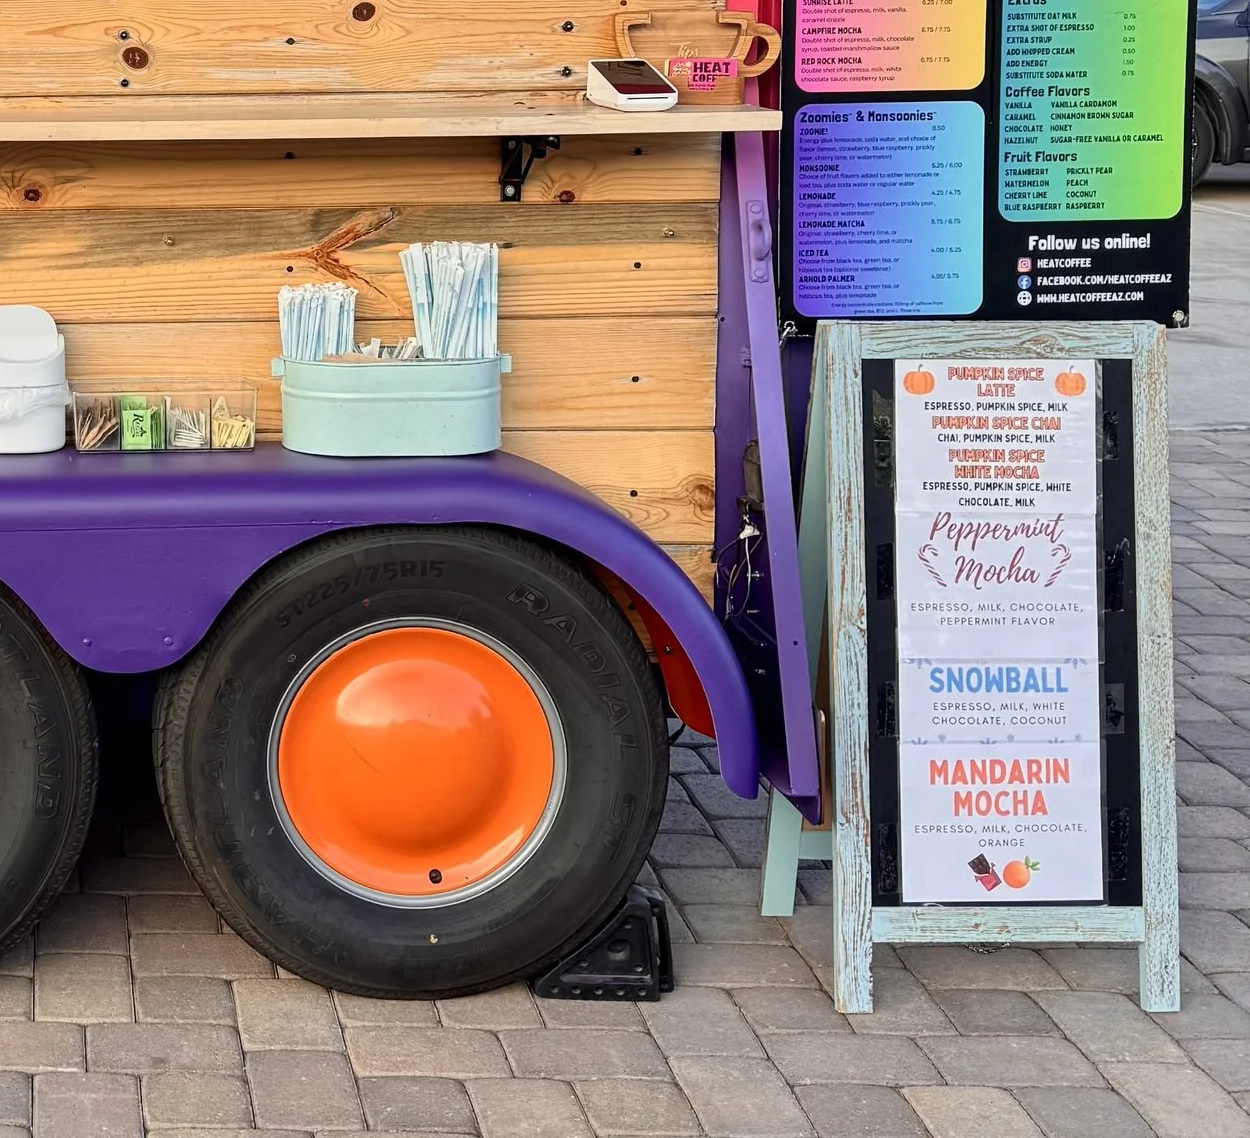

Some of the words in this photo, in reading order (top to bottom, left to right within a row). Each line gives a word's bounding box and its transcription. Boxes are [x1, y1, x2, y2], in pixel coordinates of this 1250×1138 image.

[670, 42, 699, 59] Tips
[694, 62, 730, 73] HEAT
[692, 74, 730, 82] COFF
[1006, 71, 1044, 79] SUBSTITUTE
[1006, 86, 1044, 97] Coffee
[1048, 86, 1090, 96] Flavors
[1079, 100, 1117, 108] CARDAMOM
[856, 111, 864, 122] &
[1133, 134, 1163, 142] CARAMEL
[1004, 152, 1032, 163] Fruit
[1035, 151, 1077, 162] Flavors
[799, 220, 836, 228] LEMONADE
[838, 220, 865, 228] MATCHA
[1029, 235, 1077, 250] Follow
[1082, 237, 1100, 249] us
[1105, 233, 1150, 249] online!
[1037, 258, 1092, 268] HEATCOFFEE
[799, 275, 826, 283] ARNOLD
[1037, 274, 1172, 286] FACEBOOK.COM/HEATCOFFEEAZ
[1037, 292, 1144, 303] WWW.HEATCOFFEEAZ.COM
[948, 367, 1004, 381] PUMPKIN
[1008, 367, 1044, 381] SPICE
[977, 384, 1015, 397] LATTE
[925, 402, 974, 411] ESPRESSO,
[976, 402, 1015, 411] PUMPKIN
[1018, 403, 1045, 412] SPICE,
[1048, 403, 1068, 411] MILK
[932, 416, 989, 429] PUMPKIN
[992, 417, 1028, 430] SPICE
[1031, 417, 1061, 430] CHAI
[938, 434, 961, 443] CHAI,
[964, 434, 1002, 443] PUMPKIN
[1005, 434, 1032, 443] SPICE,
[1036, 435, 1055, 443] MILK
[949, 449, 1005, 462] PUMPKIN
[1008, 450, 1045, 462] SPICE
[954, 465, 991, 478] WHITE
[994, 466, 1039, 479] MOCHA
[923, 482, 972, 491] ESPRESSO,
[974, 482, 1012, 491] PUMPKIN
[1016, 483, 1043, 492] SPICE,
[1046, 483, 1071, 491] WHITE
[959, 498, 1012, 507] CHOCOLATE,
[1015, 498, 1035, 506] MILK
[930, 512, 1065, 551] Peppermint
[954, 546, 1040, 590] Mocha
[274, 561, 446, 628] ST225/75R15
[911, 603, 973, 612] ESPRESSO,
[978, 603, 1005, 612] MILK,
[1010, 603, 1083, 612] CHOCOLATE,
[940, 617, 1006, 625] PEPPERMINT
[1012, 617, 1055, 625] FLAVOR
[506, 582, 638, 762] RADIAL
[929, 667, 1068, 693] SNOWBALL
[933, 702, 995, 711] ESPRESSO,
[1000, 703, 1028, 711] MILK,
[1032, 702, 1065, 710] WHITE
[932, 717, 1006, 725] CHOCOLATE,
[1011, 717, 1066, 725] COCONUT
[930, 758, 1070, 785] MANDARIN
[954, 790, 1048, 816] MOCHA
[915, 825, 977, 834] ESPRESSO,
[982, 824, 1010, 834] MILK,
[1015, 824, 1088, 833] CHOCOLATE,
[978, 839, 1025, 847] ORANGE
